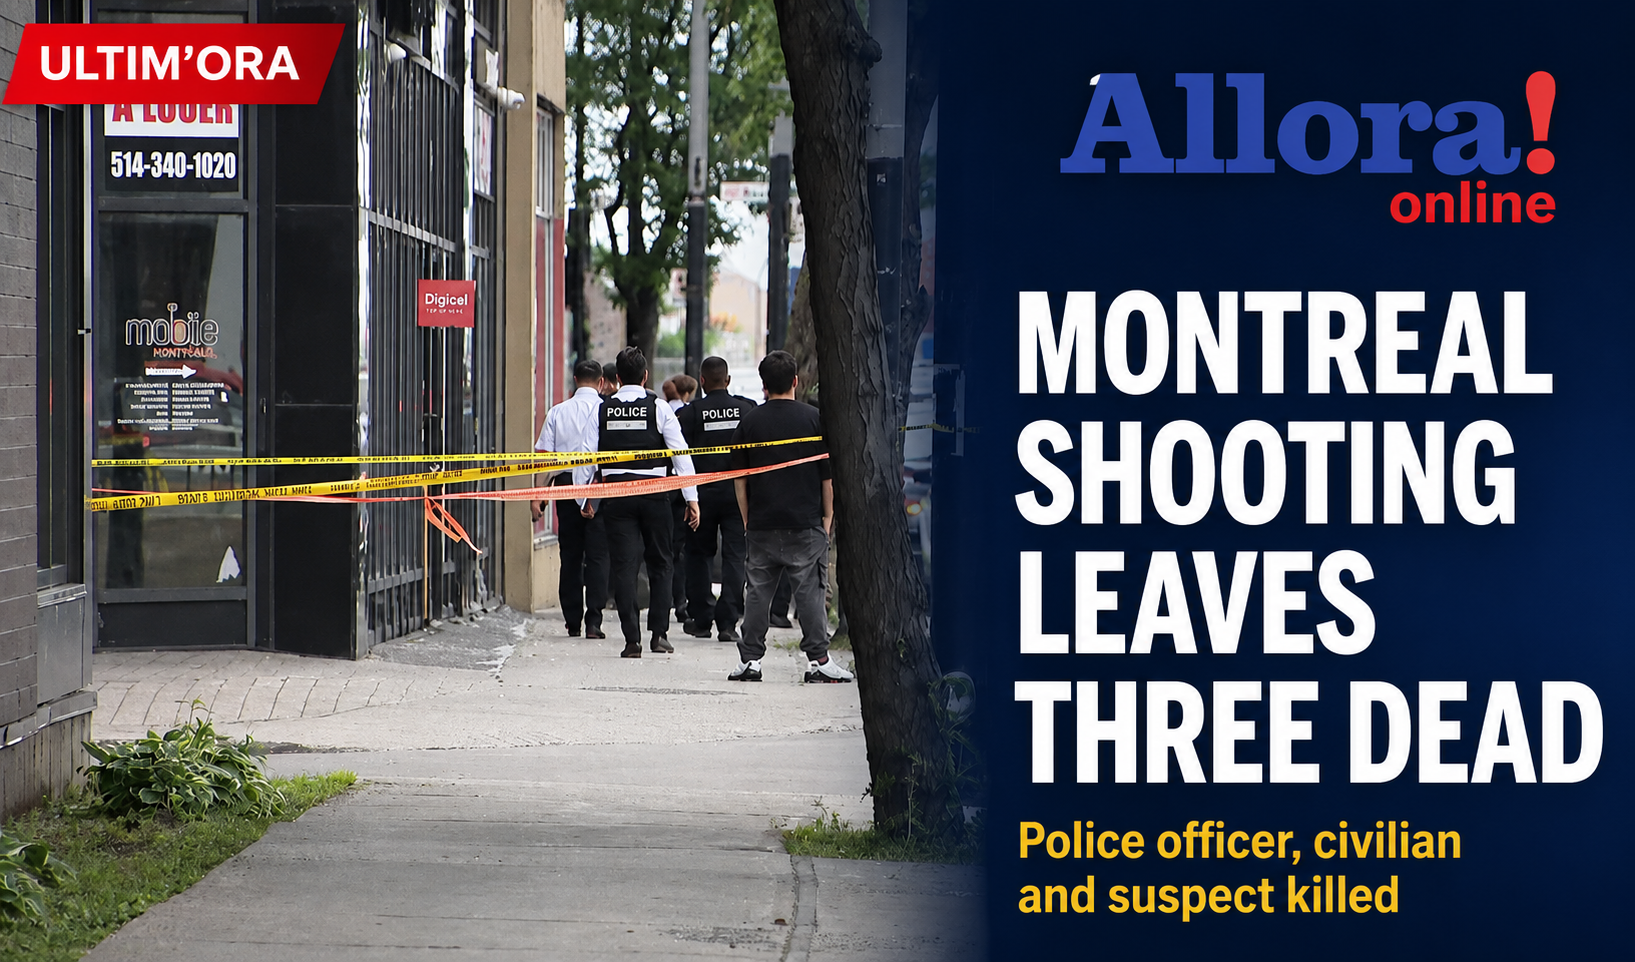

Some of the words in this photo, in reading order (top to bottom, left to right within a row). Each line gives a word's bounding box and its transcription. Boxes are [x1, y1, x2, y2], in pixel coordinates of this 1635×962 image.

[111, 151, 236, 178] 514-340-1020
[425, 293, 468, 308] Digicel
[607, 406, 647, 417] POLICE
[702, 408, 740, 420] POLICE
